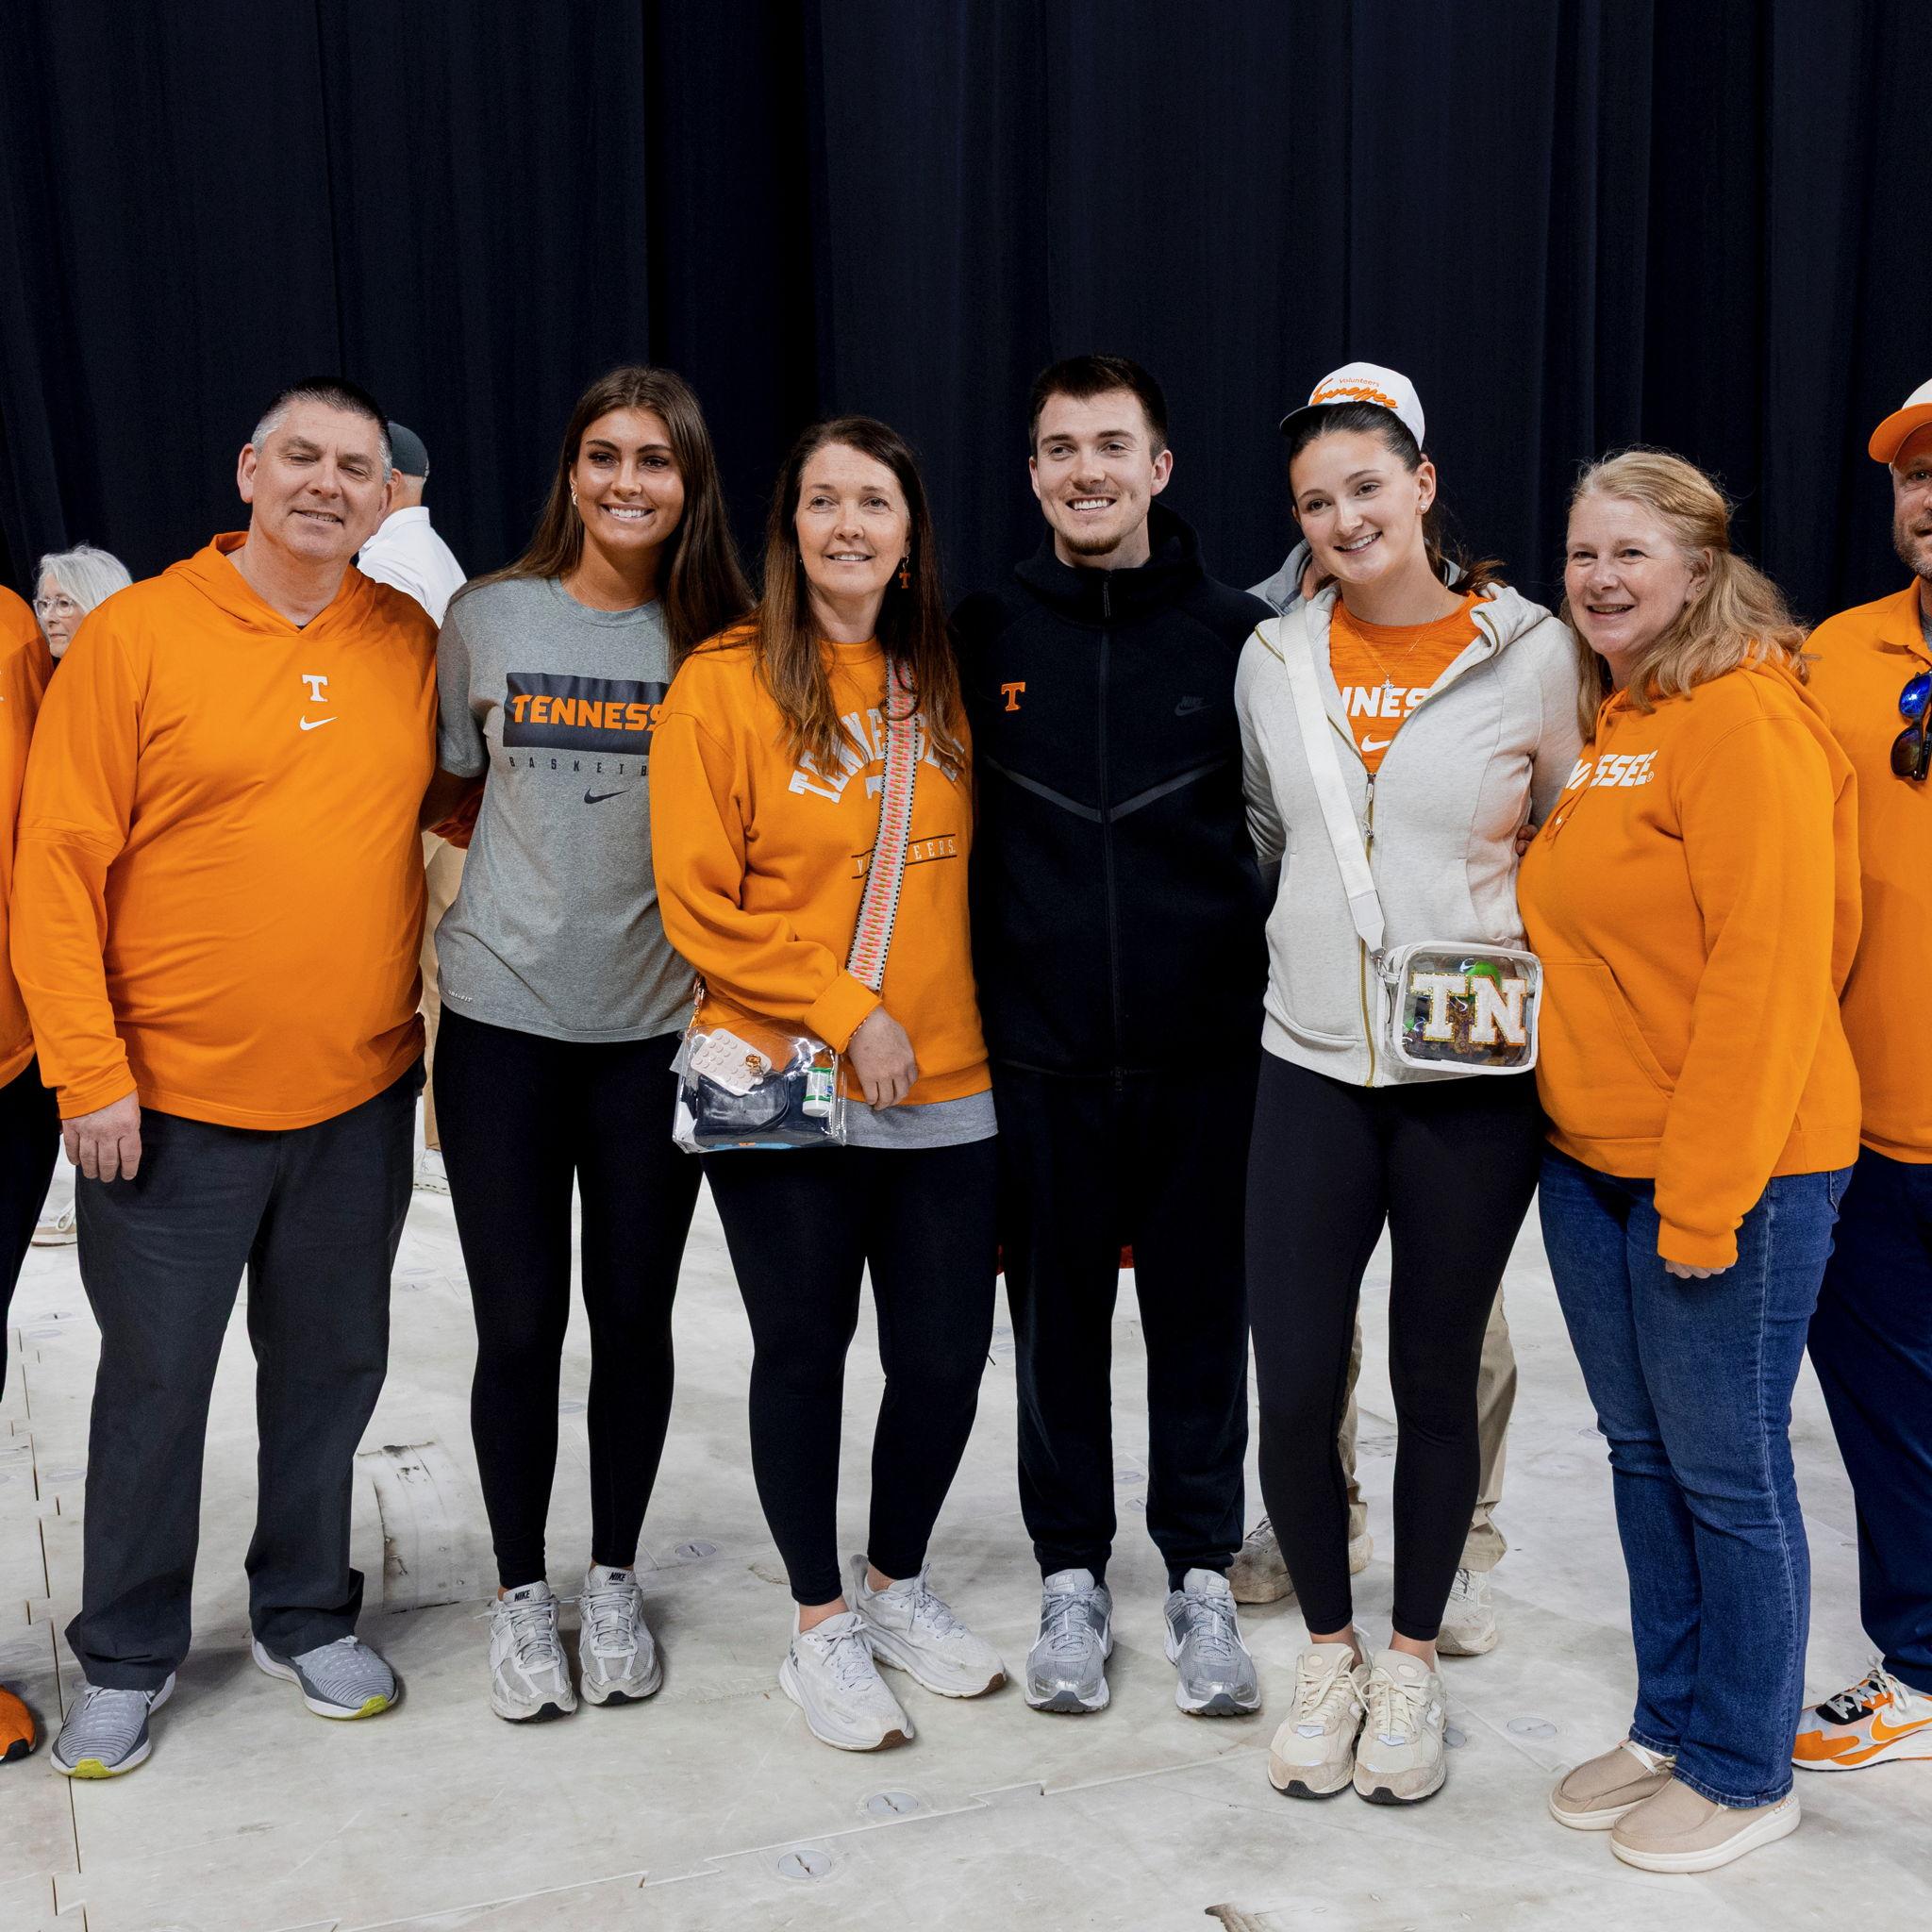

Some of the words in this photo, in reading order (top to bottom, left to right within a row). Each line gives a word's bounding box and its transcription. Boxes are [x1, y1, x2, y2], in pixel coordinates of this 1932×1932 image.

[302, 674, 328, 702] T
[1001, 681, 1026, 711] T
[608, 1572, 626, 1582] NIKE
[514, 1590, 531, 1602] NIKE
